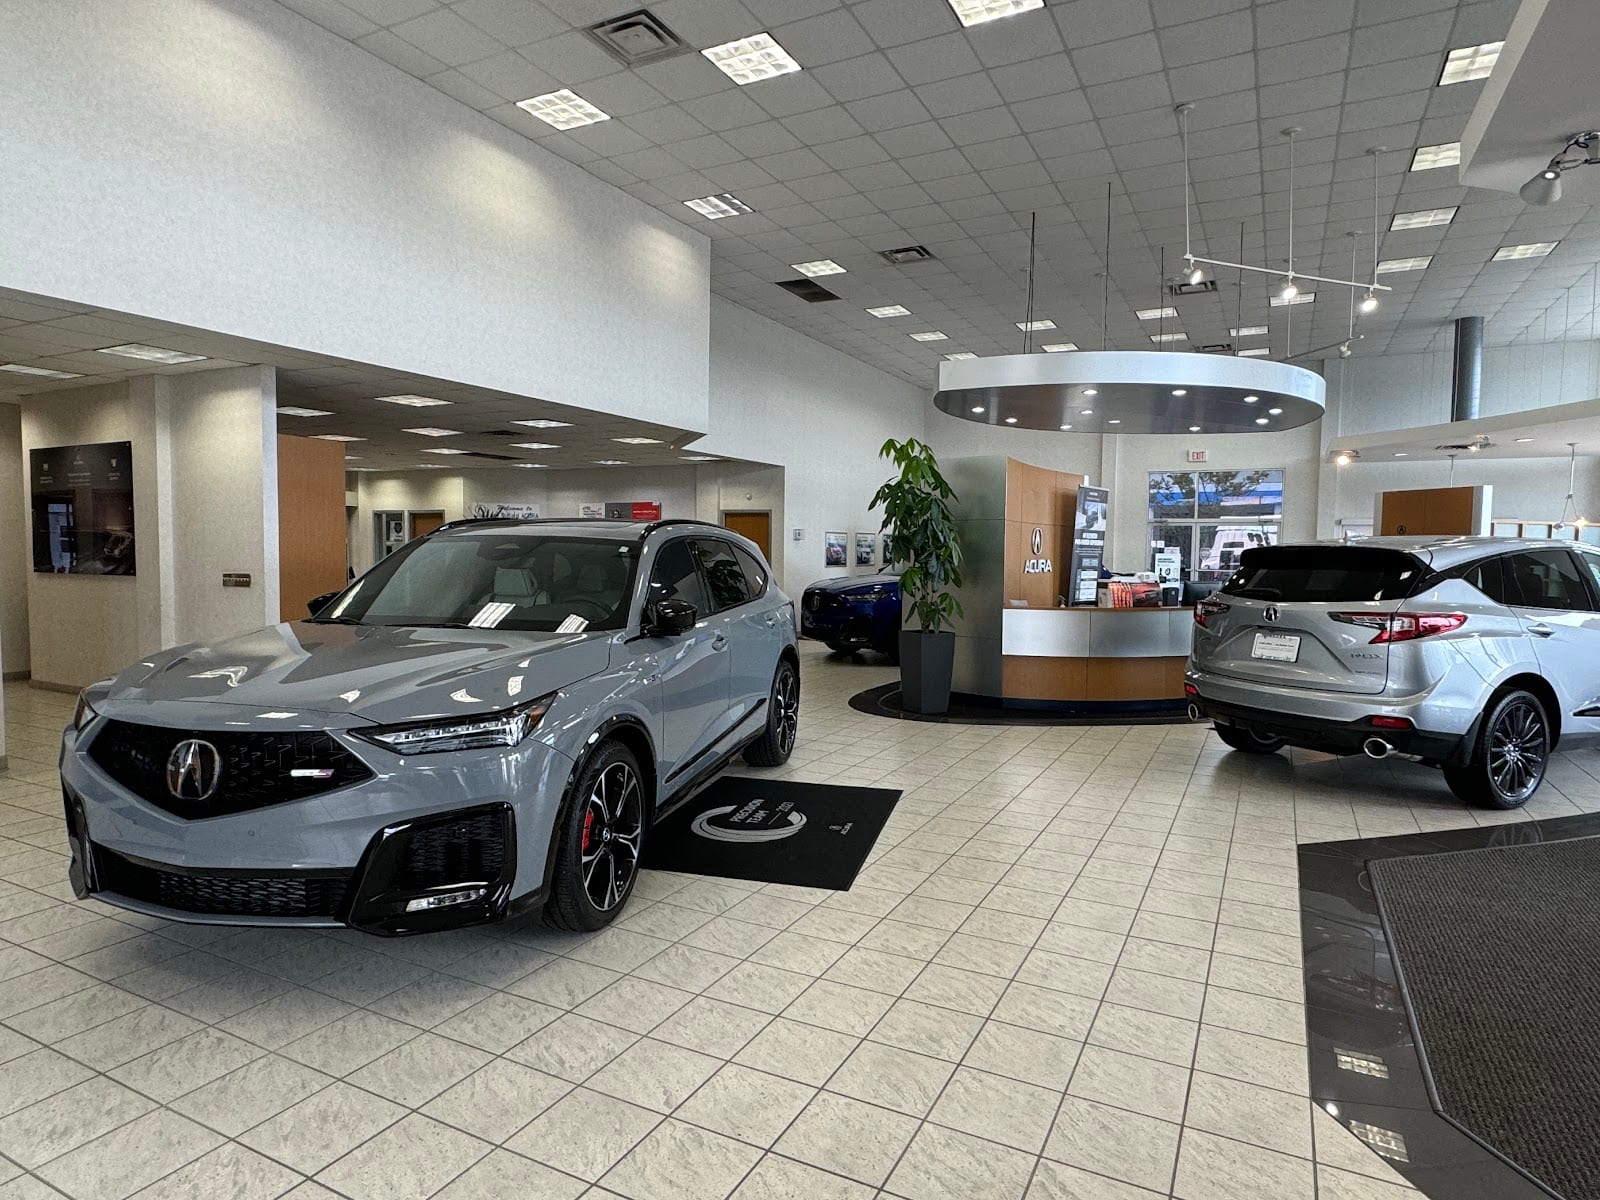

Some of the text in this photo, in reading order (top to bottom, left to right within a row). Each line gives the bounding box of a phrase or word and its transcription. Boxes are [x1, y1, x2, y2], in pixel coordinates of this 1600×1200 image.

[1192, 451, 1205, 460] EXIT
[1024, 559, 1053, 573] ACURA
[729, 798, 765, 823] PRECISION
[746, 810, 770, 824] TEAM
